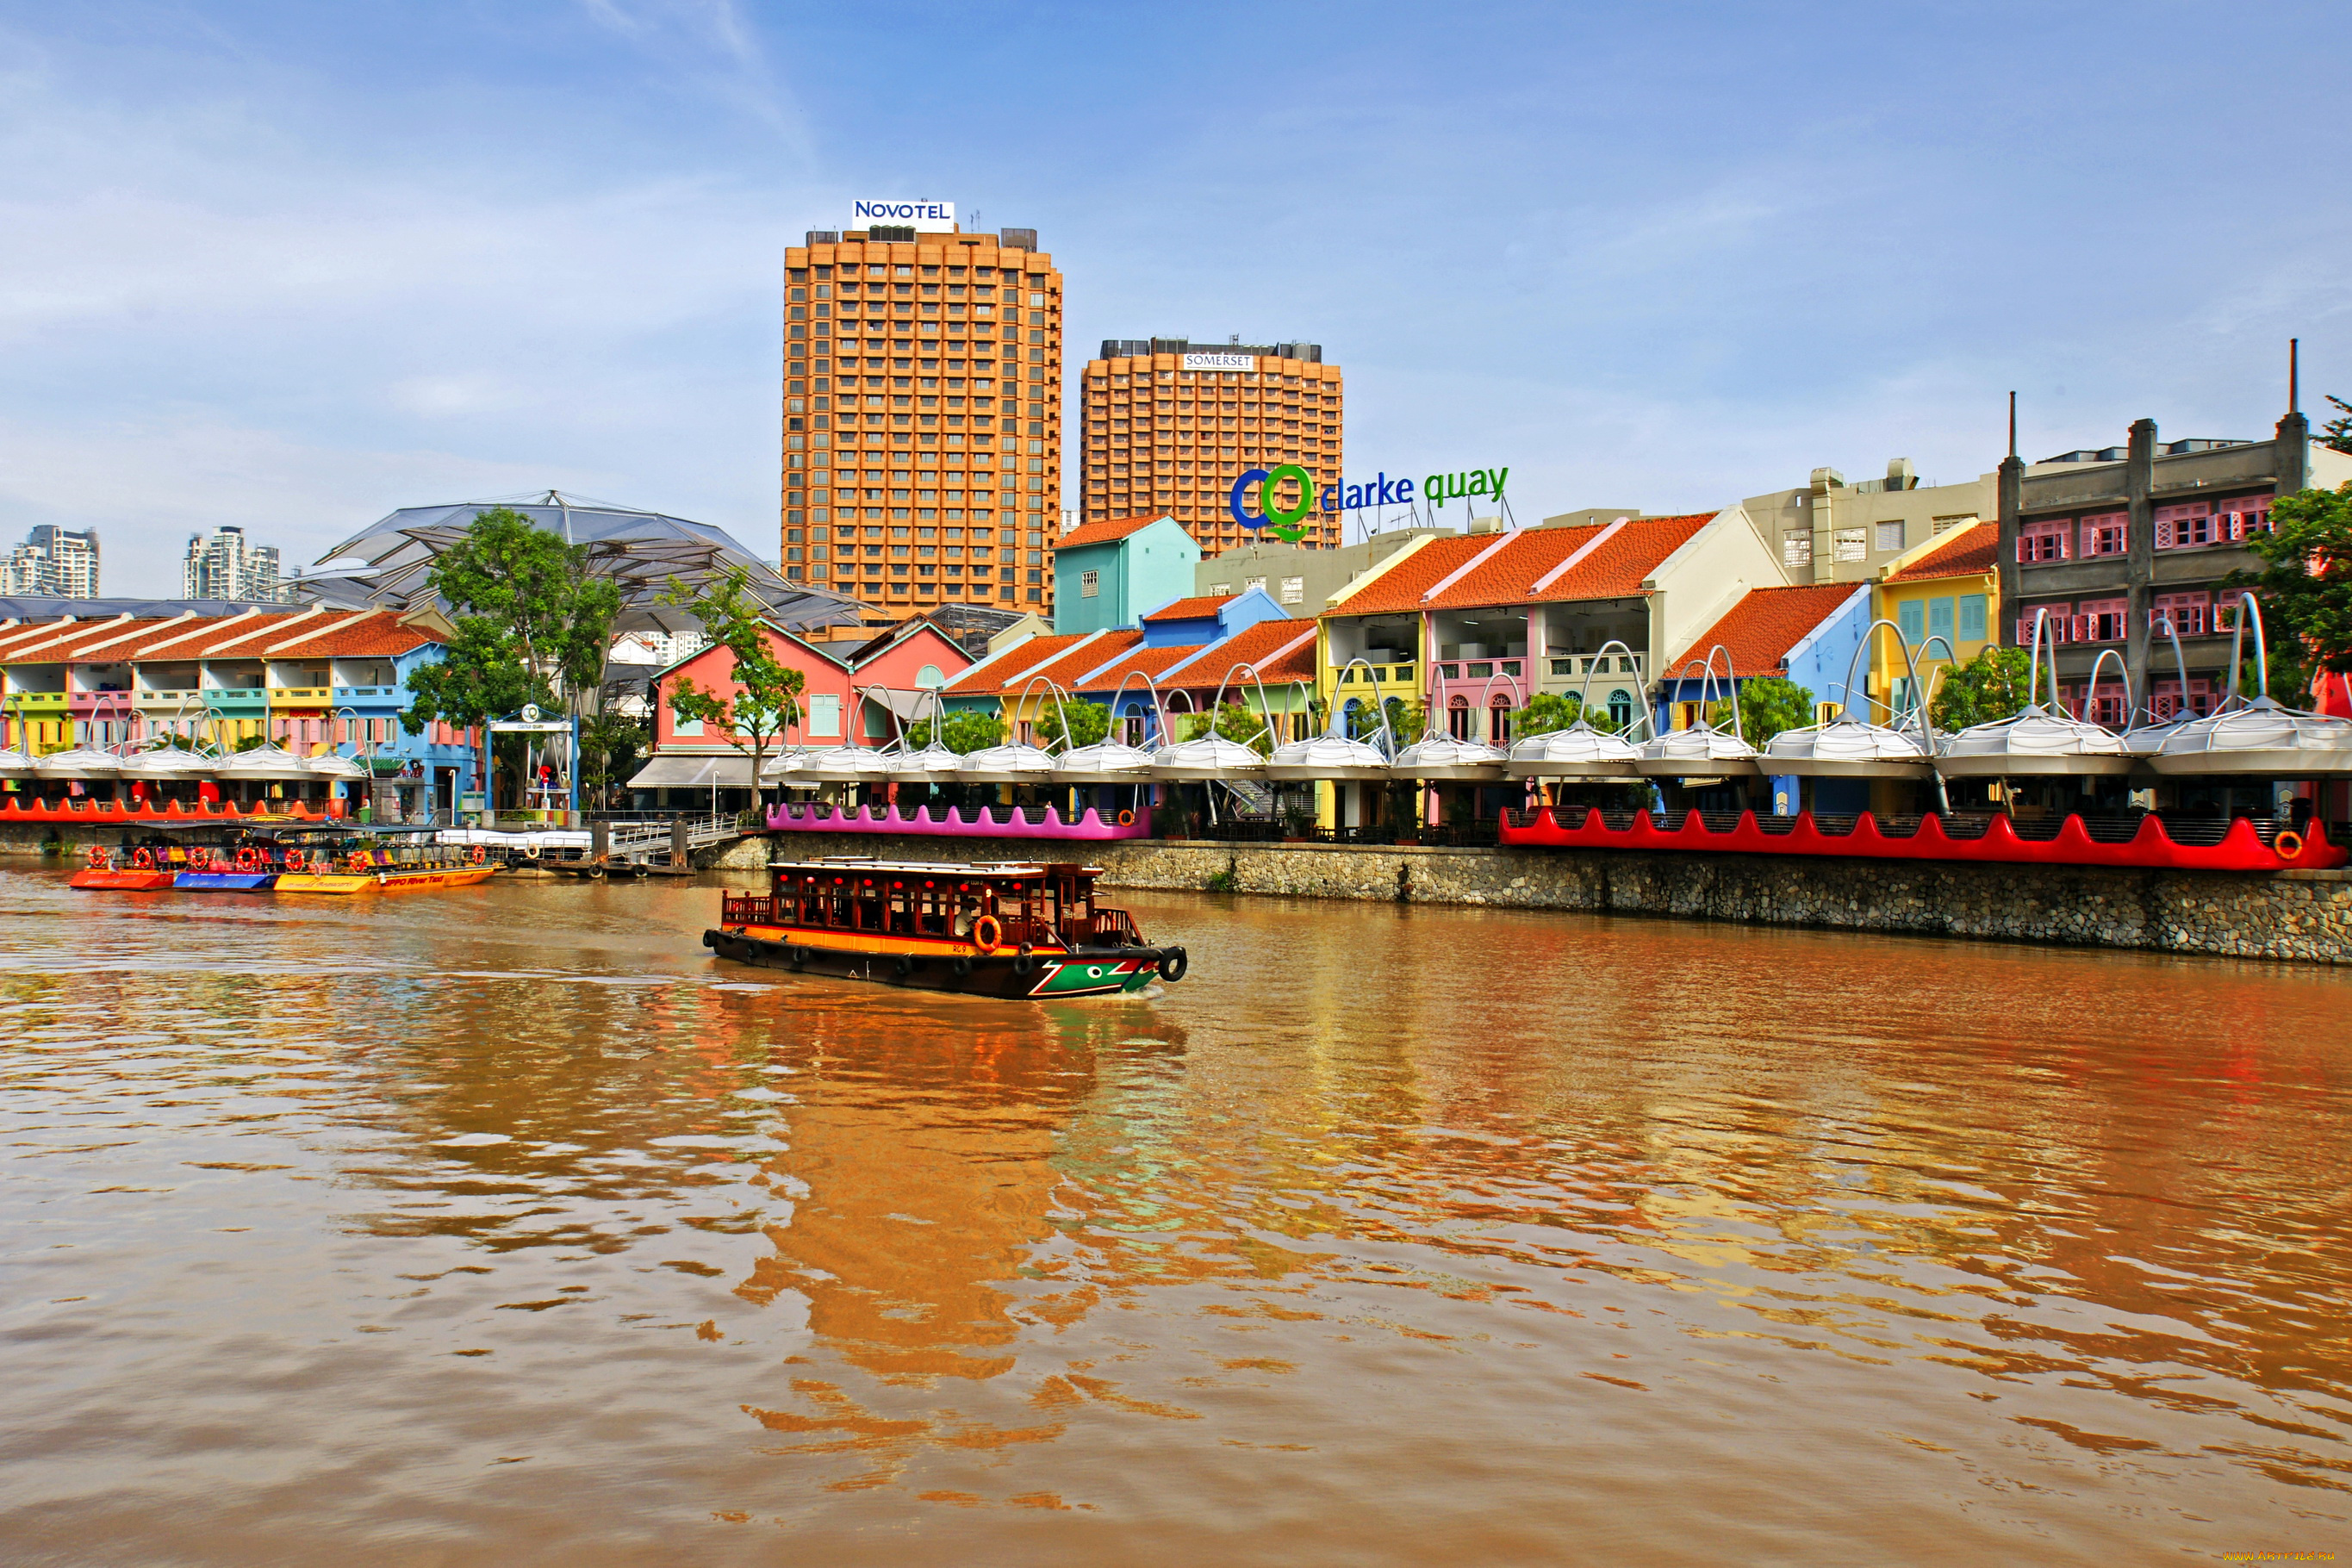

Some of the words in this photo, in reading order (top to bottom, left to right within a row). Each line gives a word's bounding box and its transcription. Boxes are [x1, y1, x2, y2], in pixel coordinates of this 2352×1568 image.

[855, 201, 950, 219] NOVOTEL
[1186, 355, 1251, 366] SOMERSET
[1321, 471, 1415, 512] clarke
[1424, 467, 1509, 508] quay
[408, 877, 428, 886] River
[986, 888, 992, 898] 9
